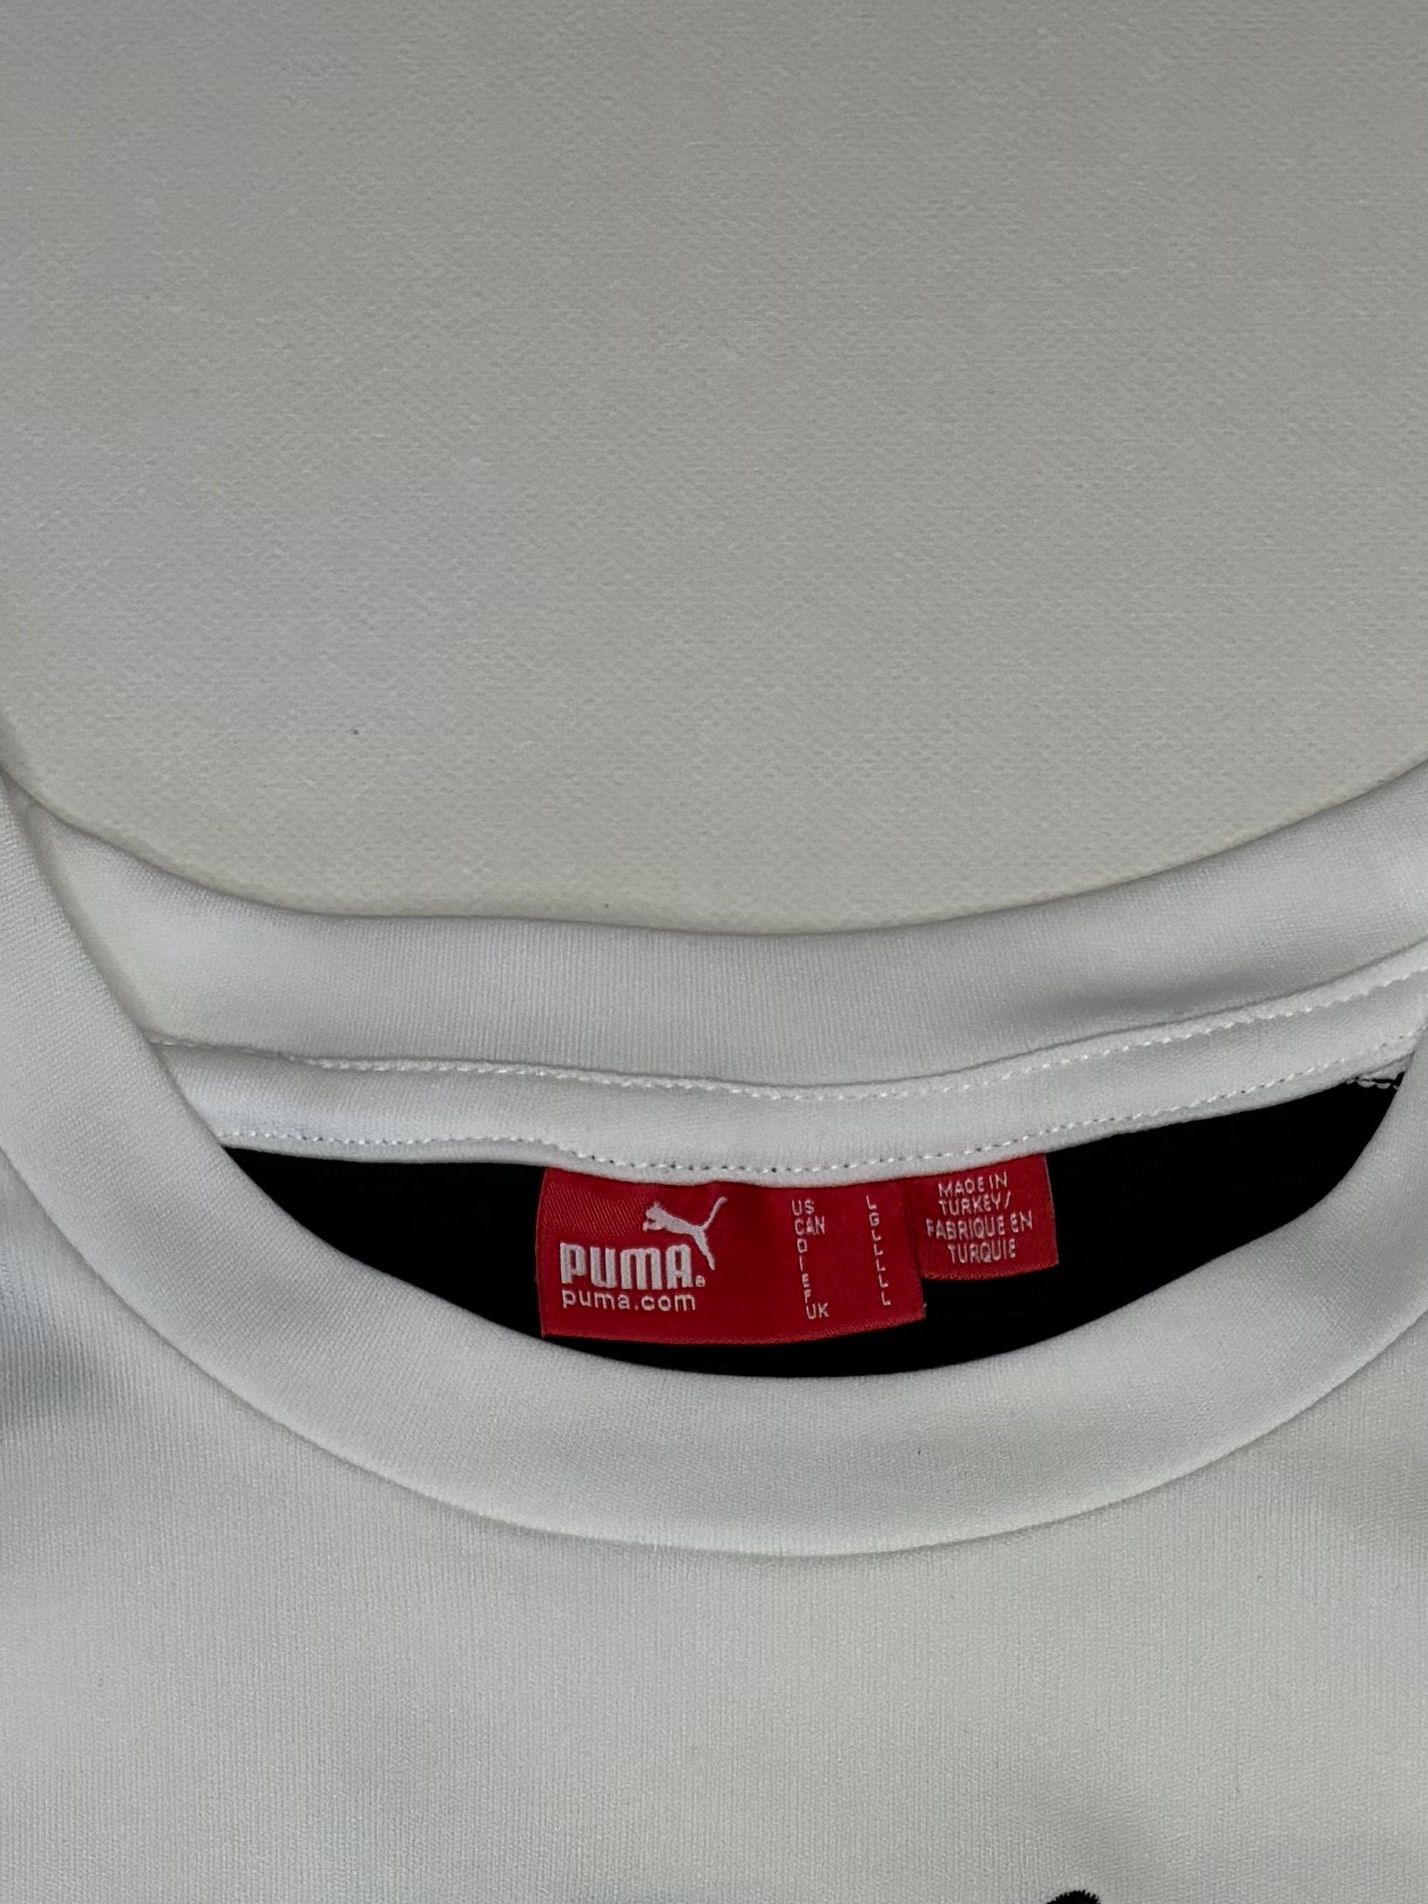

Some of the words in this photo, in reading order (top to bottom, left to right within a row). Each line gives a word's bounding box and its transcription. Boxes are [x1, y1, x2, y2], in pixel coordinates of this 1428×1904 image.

[938, 1176, 985, 1198] MADE
[989, 1169, 1008, 1190] IN
[792, 1198, 814, 1216] US
[866, 1195, 877, 1210] L
[794, 1216, 825, 1236] CAN
[872, 1229, 882, 1242] L
[926, 1215, 1006, 1240] FABRIQUE
[1010, 1208, 1033, 1233] EN
[873, 1243, 883, 1256] L
[947, 1238, 1016, 1264] TURQUIE
[802, 1273, 810, 1288] E
[876, 1258, 886, 1271] L
[879, 1273, 889, 1288] L
[561, 1289, 696, 1312] puma.com
[806, 1302, 829, 1320] UK
[881, 1290, 891, 1306] L
